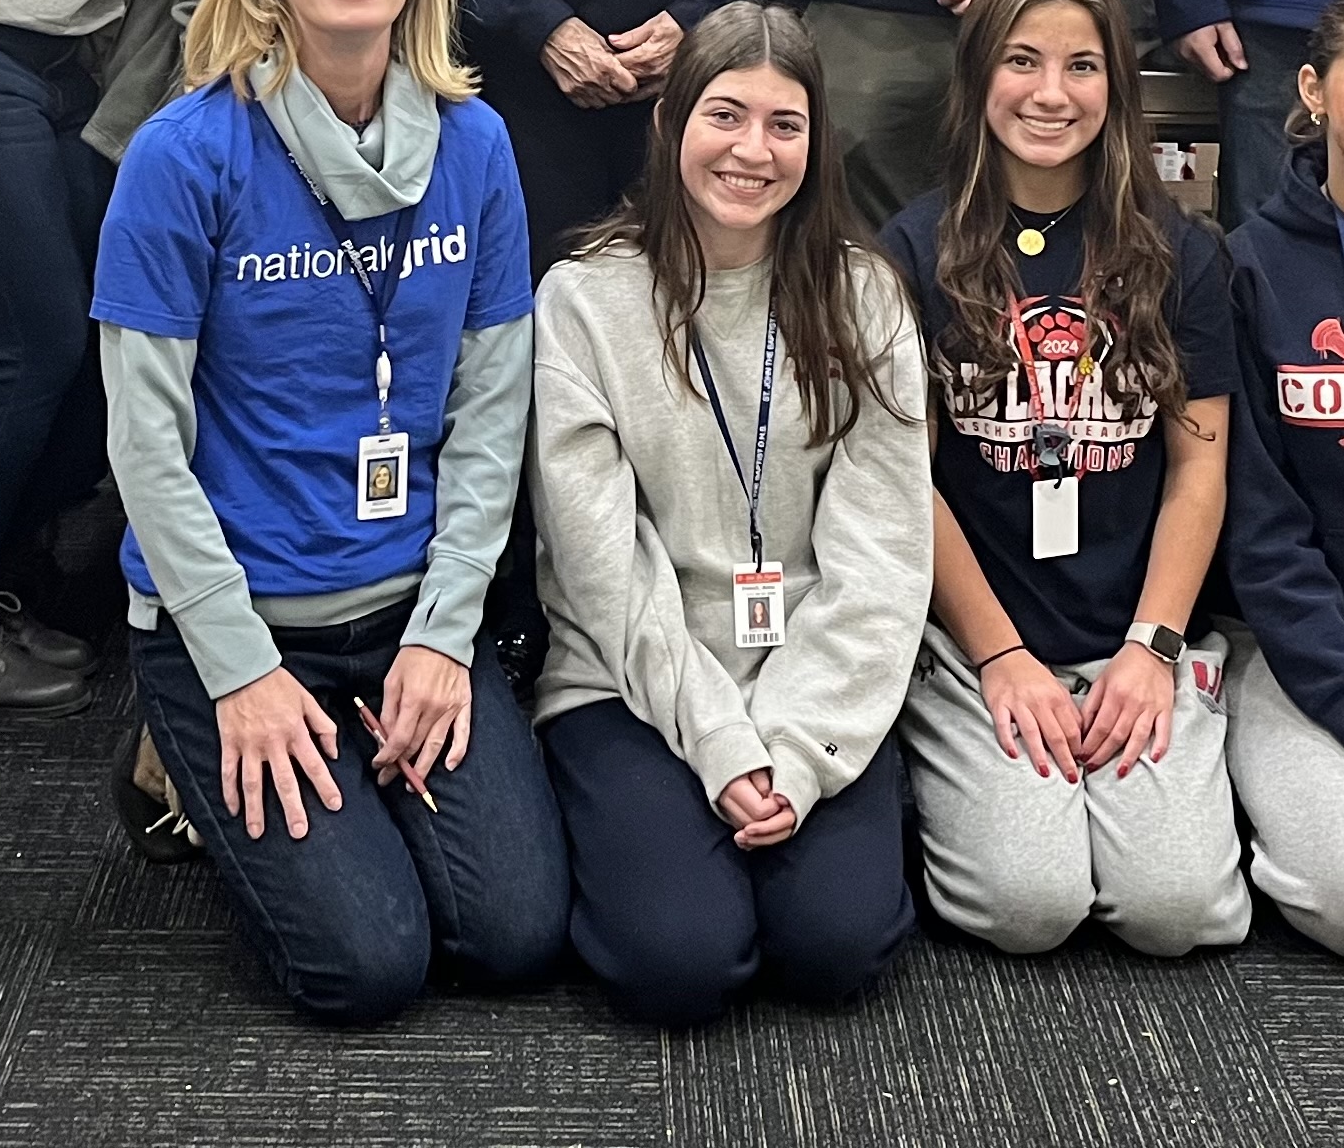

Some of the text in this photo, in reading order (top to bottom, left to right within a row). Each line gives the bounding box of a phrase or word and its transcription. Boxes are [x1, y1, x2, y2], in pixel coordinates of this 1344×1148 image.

[237, 223, 466, 282] nationalgrid
[1043, 339, 1079, 354] 2024
[765, 351, 774, 367] THE
[979, 442, 1135, 473] CHAIONS
